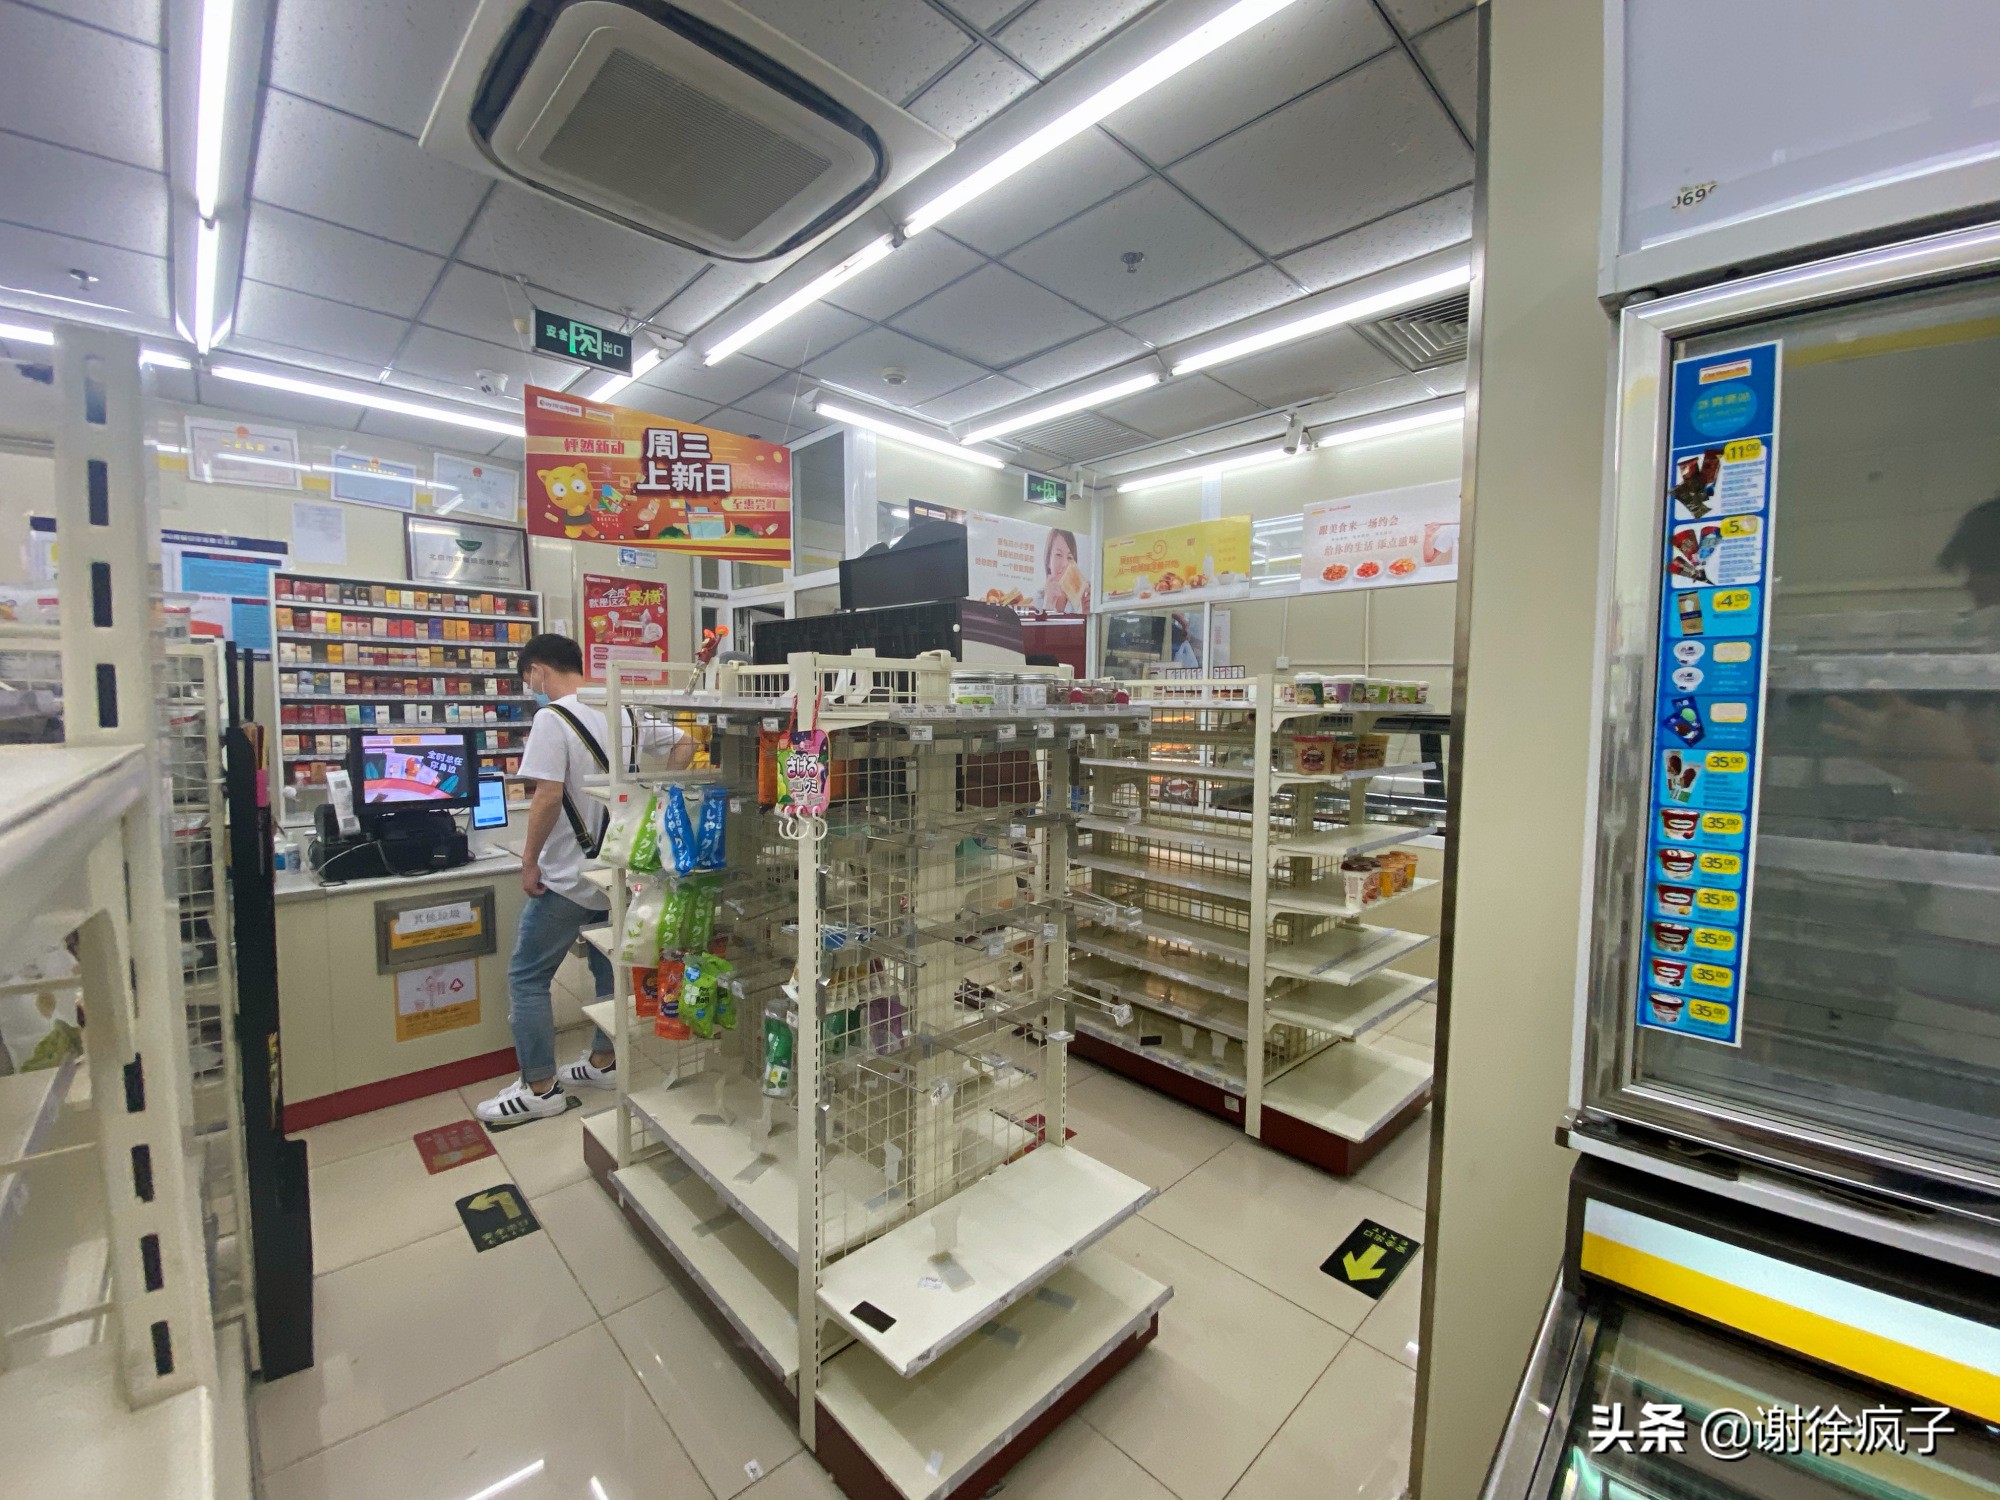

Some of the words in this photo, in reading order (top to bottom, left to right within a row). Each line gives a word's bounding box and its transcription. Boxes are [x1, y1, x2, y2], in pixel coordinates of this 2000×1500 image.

[546, 324, 568, 342] 安全
[603, 341, 624, 358] 出口
[563, 438, 625, 455] 怦然新动
[646, 429, 712, 460] 周三
[637, 460, 731, 492] 上新日
[1318, 514, 1399, 536] 跟美食来一场约会
[602, 587, 627, 599] 会员
[628, 589, 663, 607] 豪横
[786, 754, 818, 779] さける
